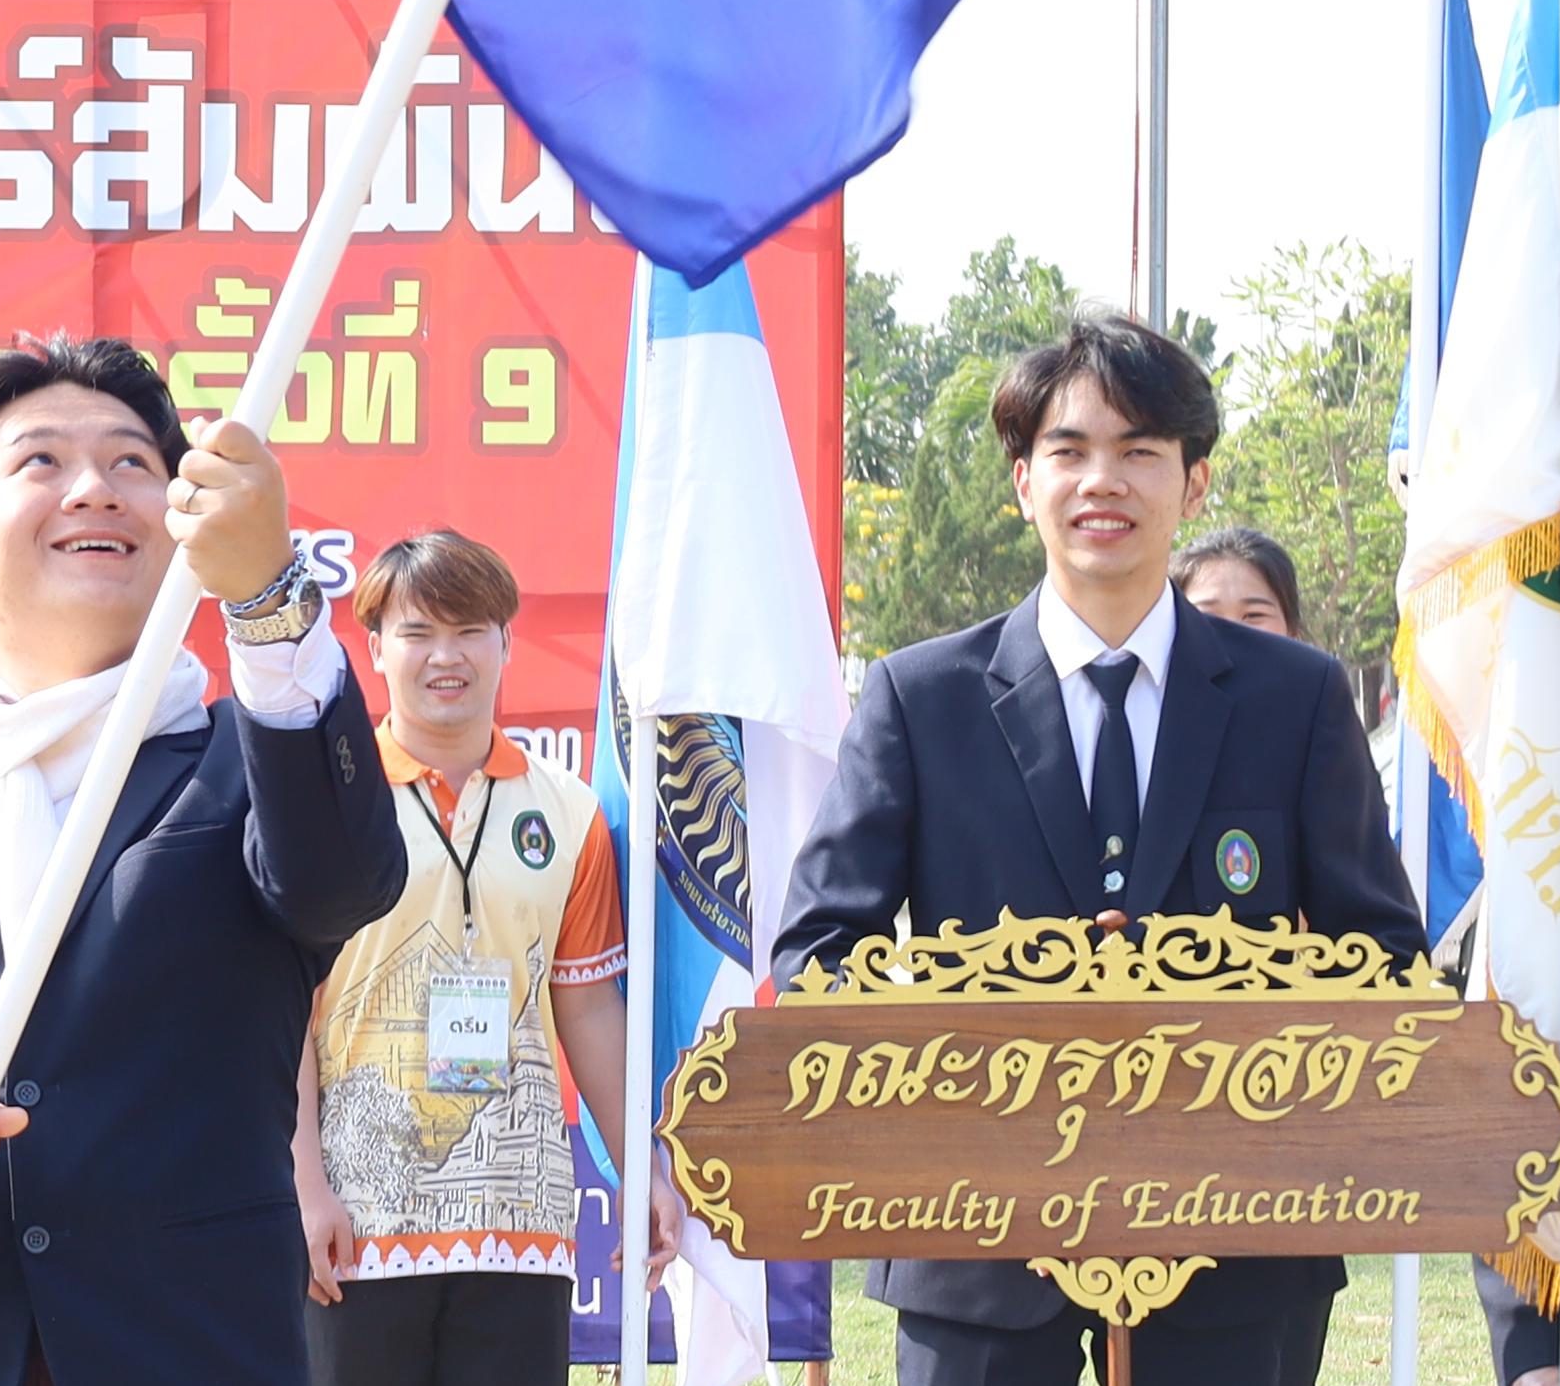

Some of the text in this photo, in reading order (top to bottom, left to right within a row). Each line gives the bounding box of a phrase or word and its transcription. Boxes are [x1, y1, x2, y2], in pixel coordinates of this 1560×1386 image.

[783, 1005, 1466, 1167] คณะครุศาสตร์
[801, 1172, 1421, 1249] Faculty of Education
